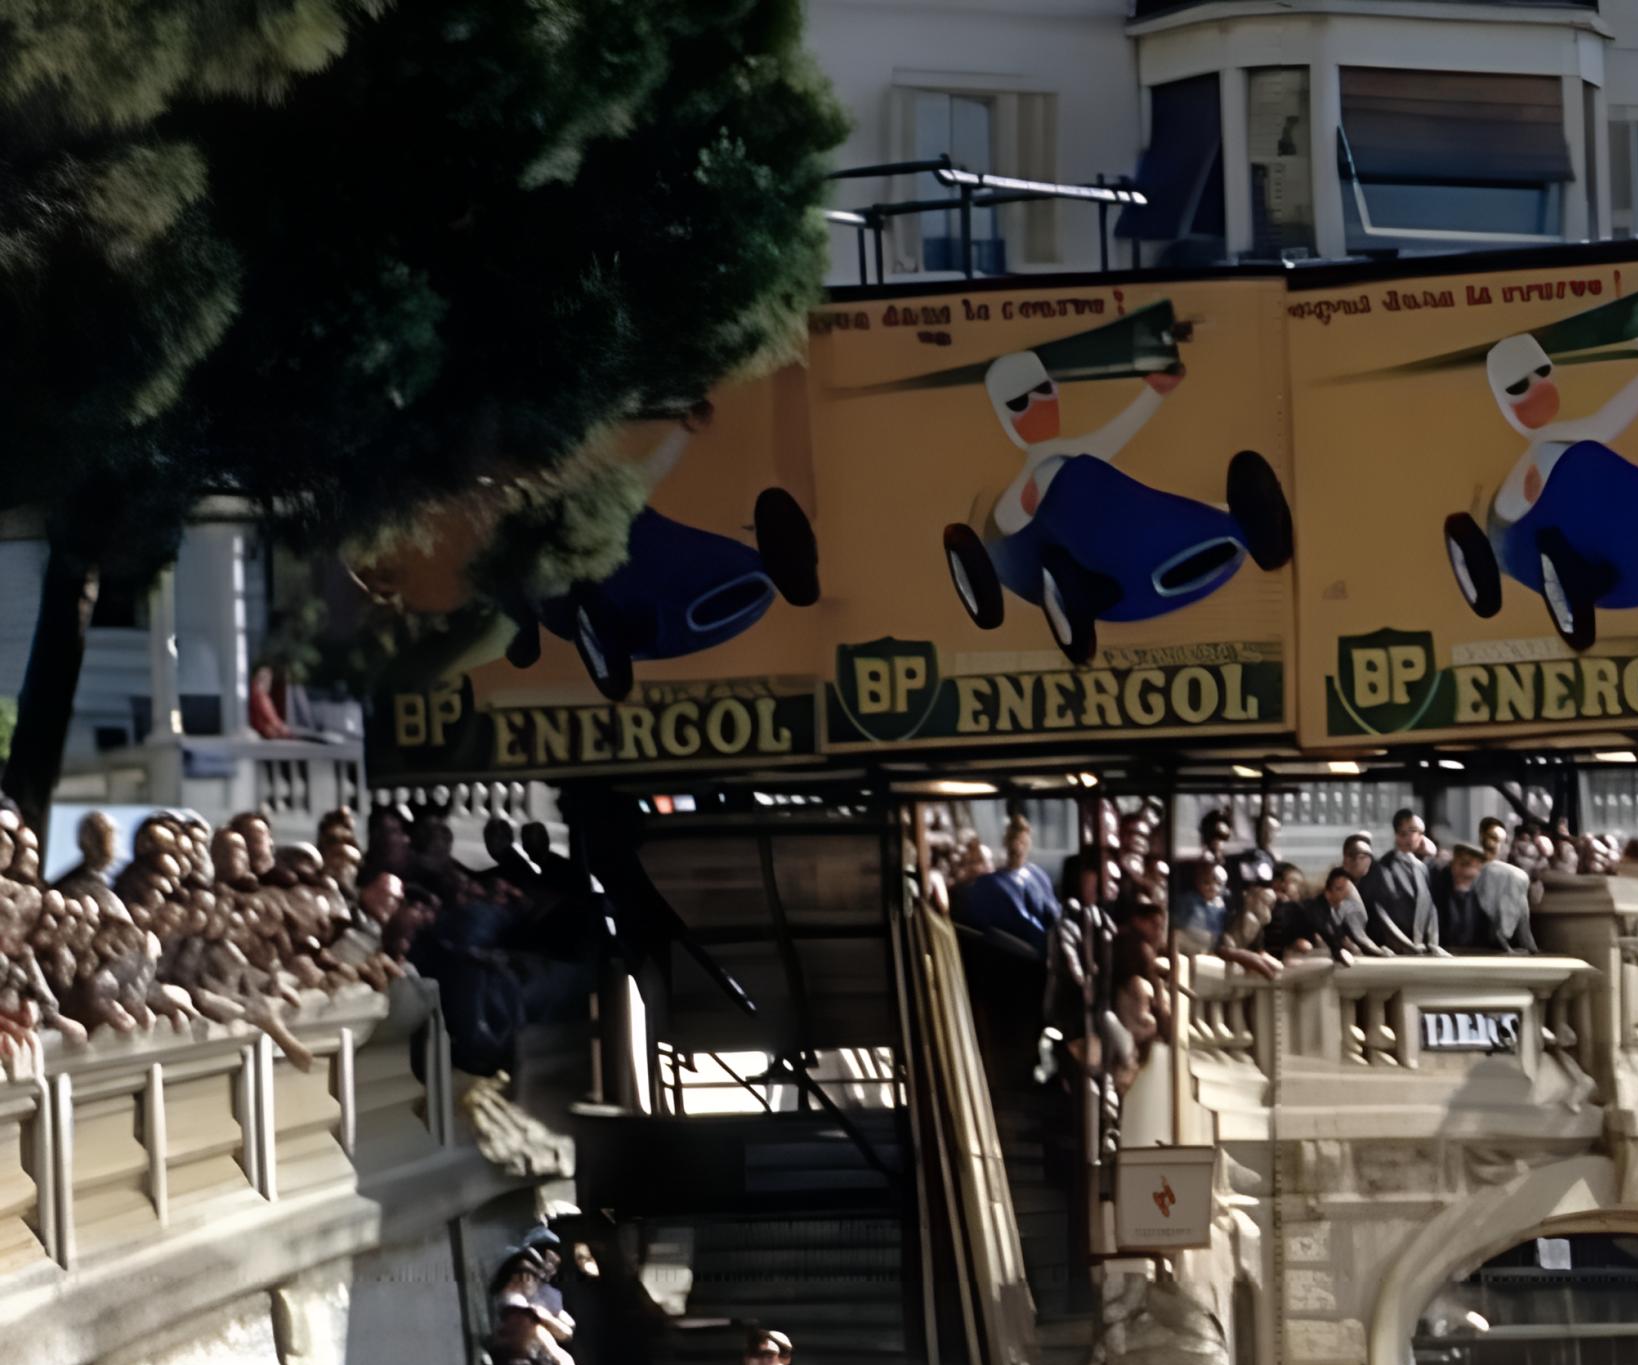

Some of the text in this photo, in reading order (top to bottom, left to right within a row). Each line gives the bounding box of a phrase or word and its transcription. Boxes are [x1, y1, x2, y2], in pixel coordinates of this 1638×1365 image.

[853, 656, 1259, 733] BP ENERGOL
[1351, 646, 1427, 708] BP
[394, 691, 793, 764] BP ENERGOL
